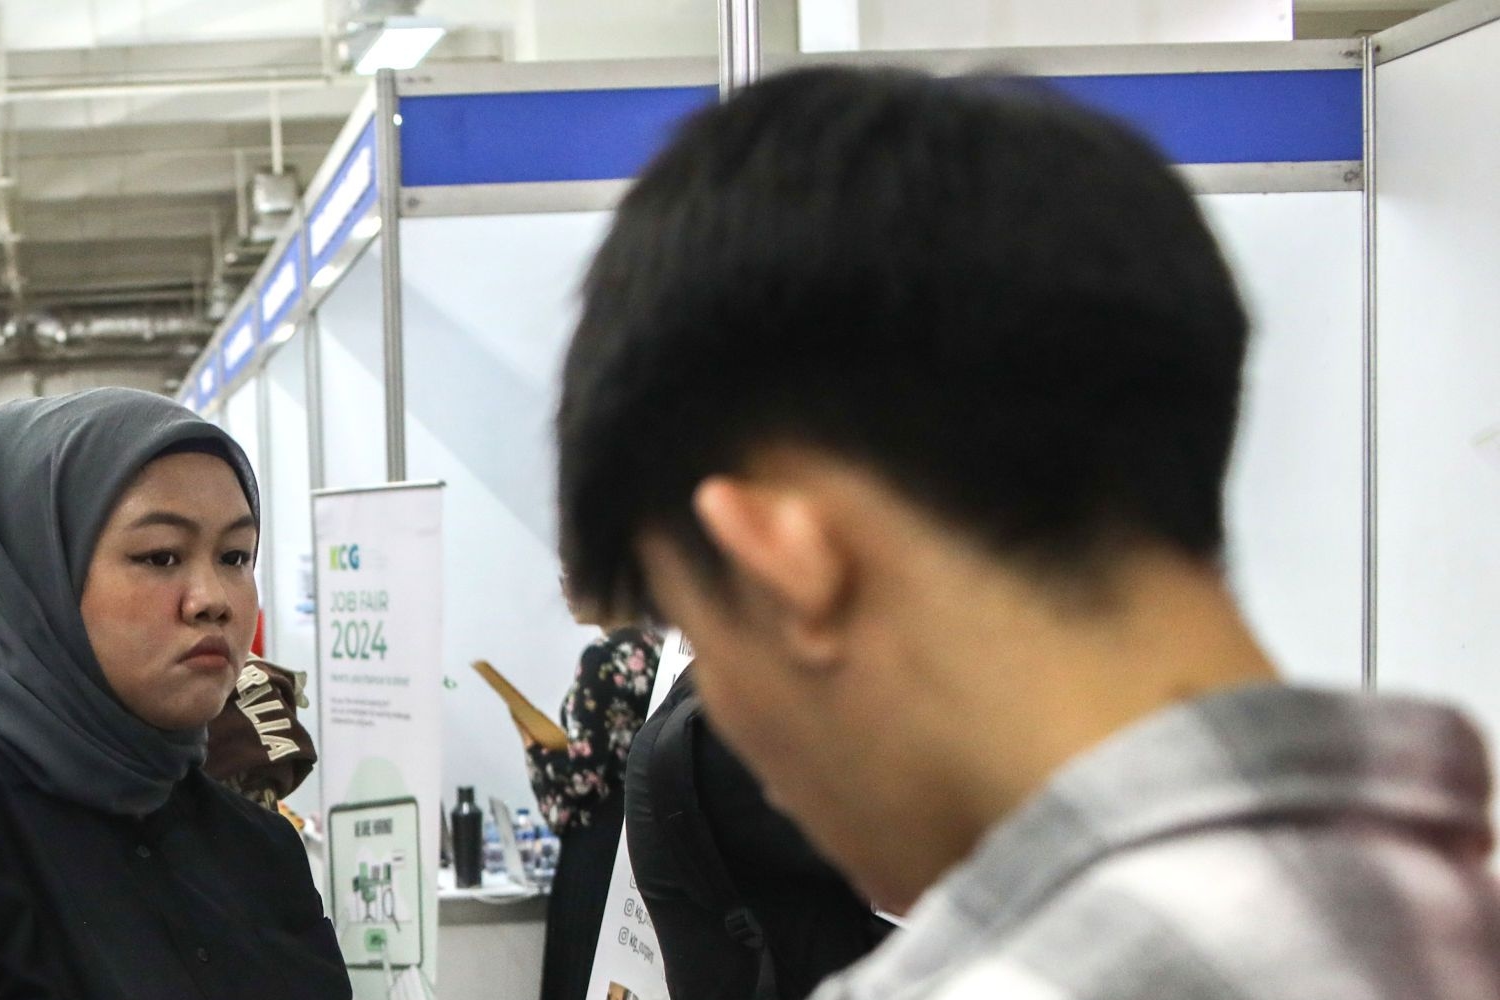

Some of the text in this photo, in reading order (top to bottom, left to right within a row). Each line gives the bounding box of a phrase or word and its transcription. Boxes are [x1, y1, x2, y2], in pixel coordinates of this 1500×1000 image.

[330, 590, 388, 612] JOB FAIR
[330, 619, 388, 660] 2024
